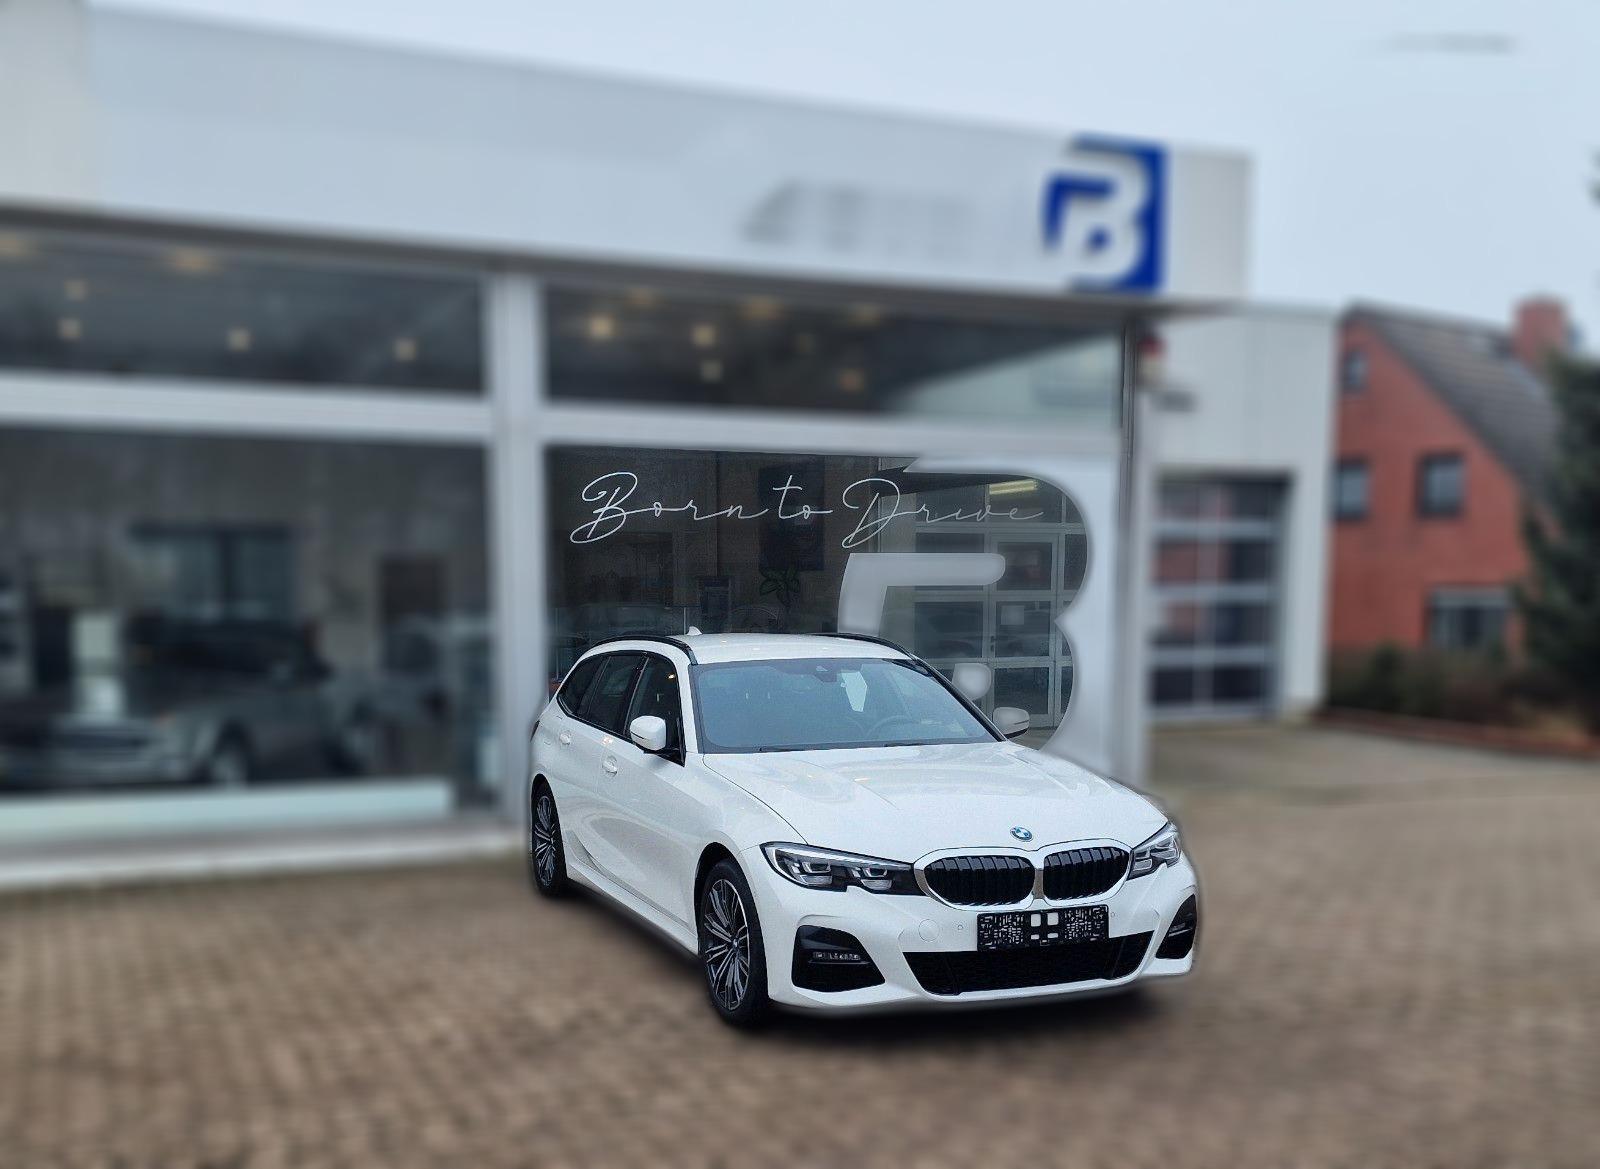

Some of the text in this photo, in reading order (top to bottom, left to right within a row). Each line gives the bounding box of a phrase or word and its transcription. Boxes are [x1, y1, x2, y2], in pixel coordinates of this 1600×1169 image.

[570, 471, 1044, 548] Born to Drive
